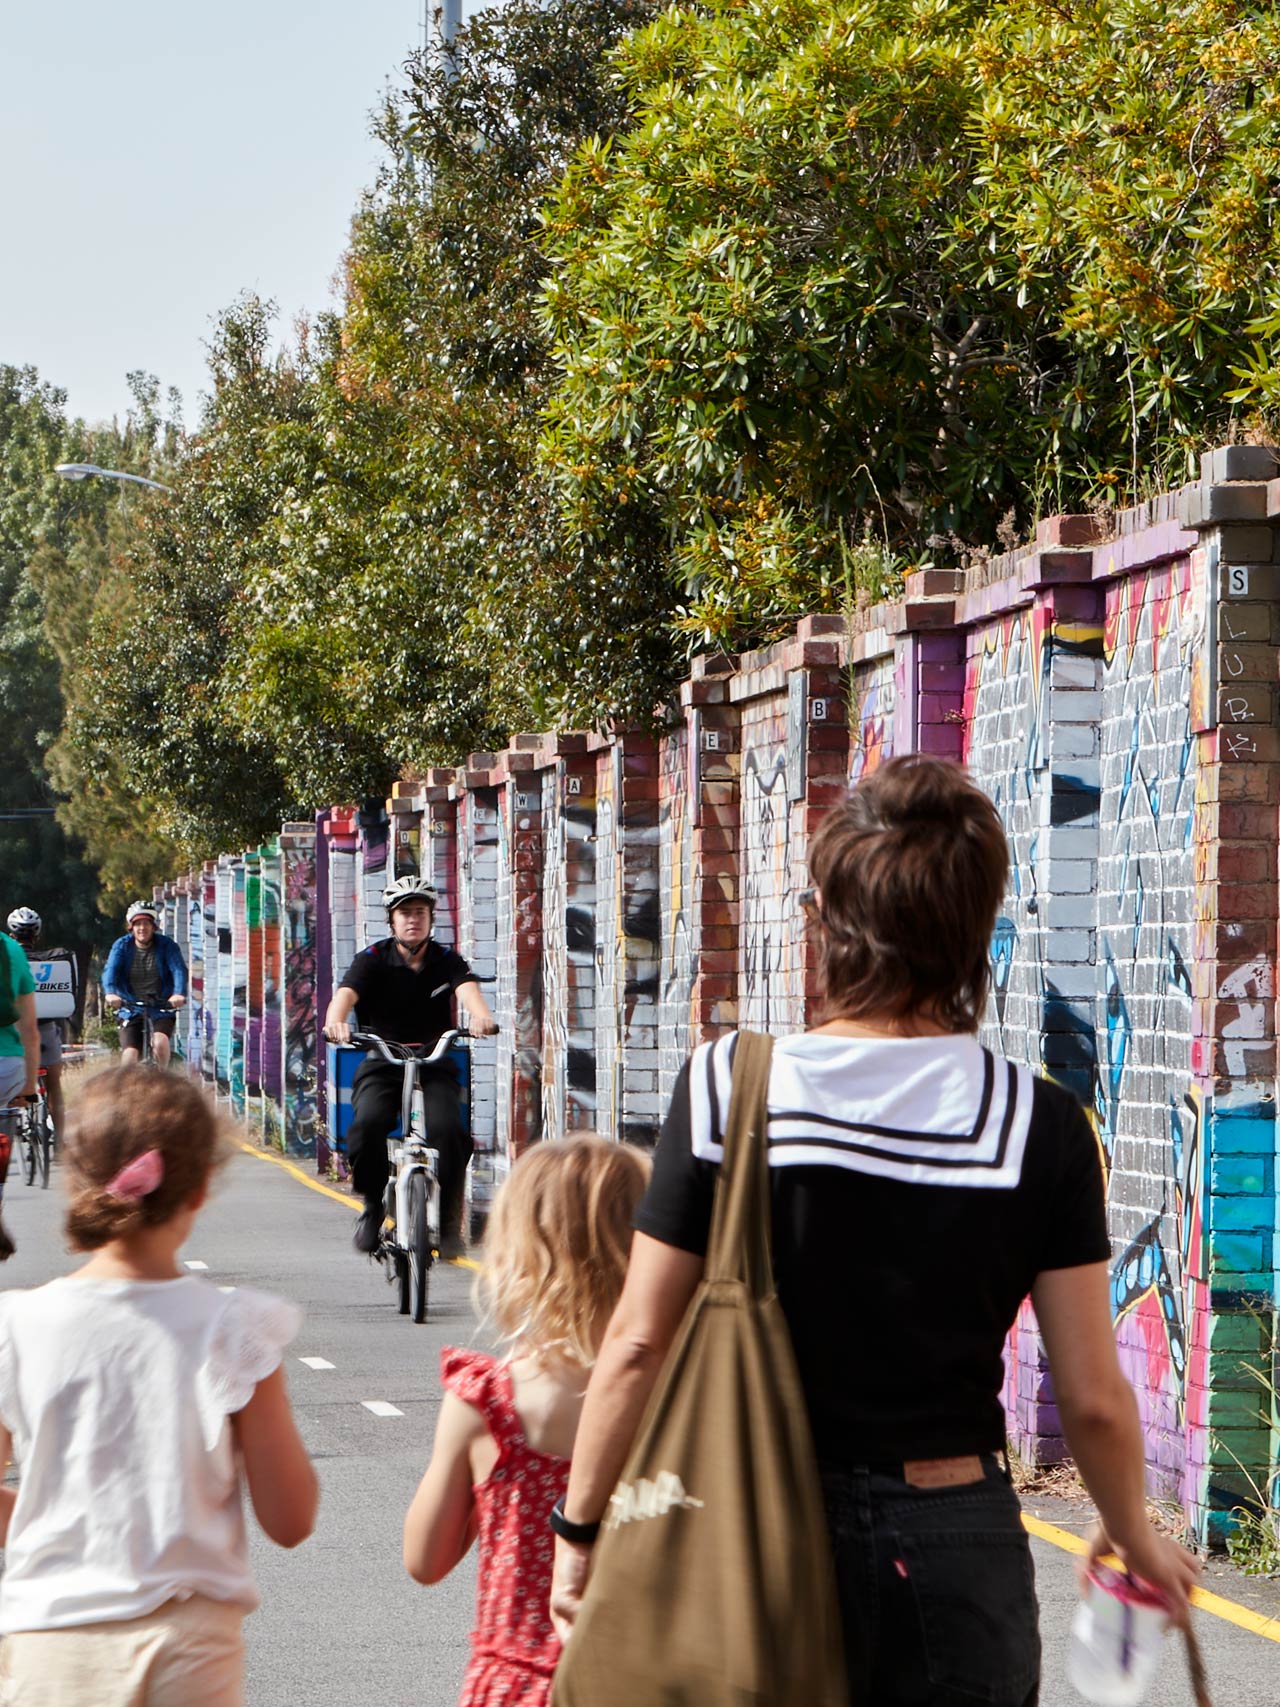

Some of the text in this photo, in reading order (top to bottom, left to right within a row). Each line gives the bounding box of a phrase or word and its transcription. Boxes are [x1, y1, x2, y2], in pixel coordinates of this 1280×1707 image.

[1232, 569, 1245, 591] S
[815, 701, 824, 717] B
[707, 733, 716, 748] E
[570, 780, 579, 791] A
[518, 794, 527, 806] W
[436, 823, 444, 832] S
[39, 982, 70, 991] BIKES
